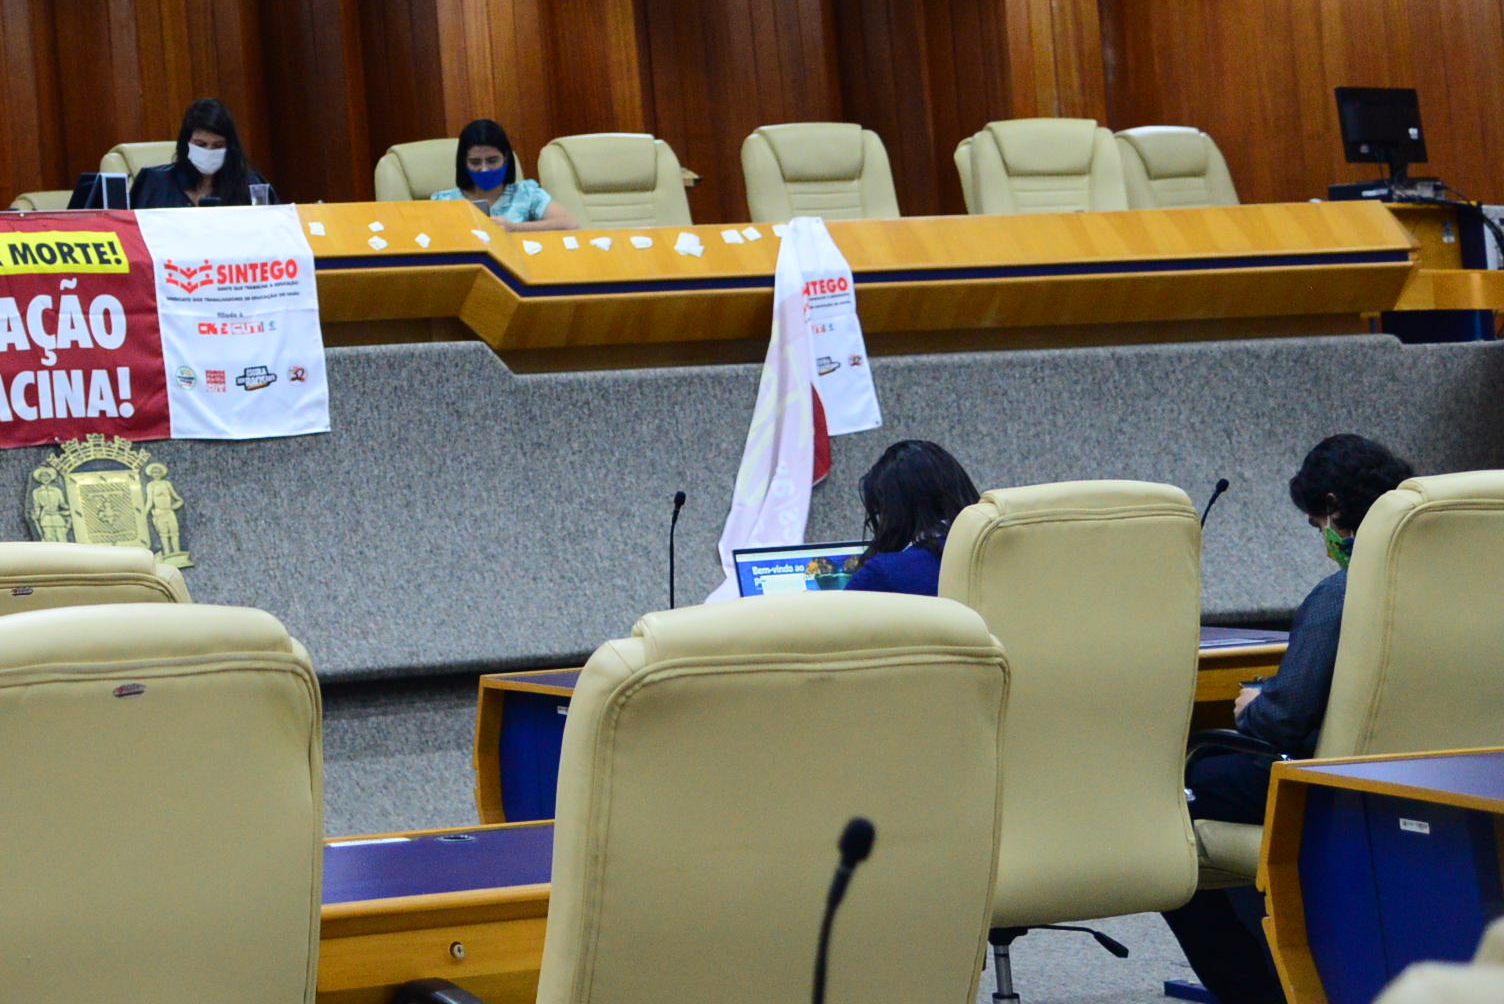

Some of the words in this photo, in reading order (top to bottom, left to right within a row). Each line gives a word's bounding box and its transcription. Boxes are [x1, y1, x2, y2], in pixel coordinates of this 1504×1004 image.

[7, 241, 122, 267] MORTE!
[217, 259, 299, 285] SINTEGO
[752, 563, 794, 575] Bem-vindo
